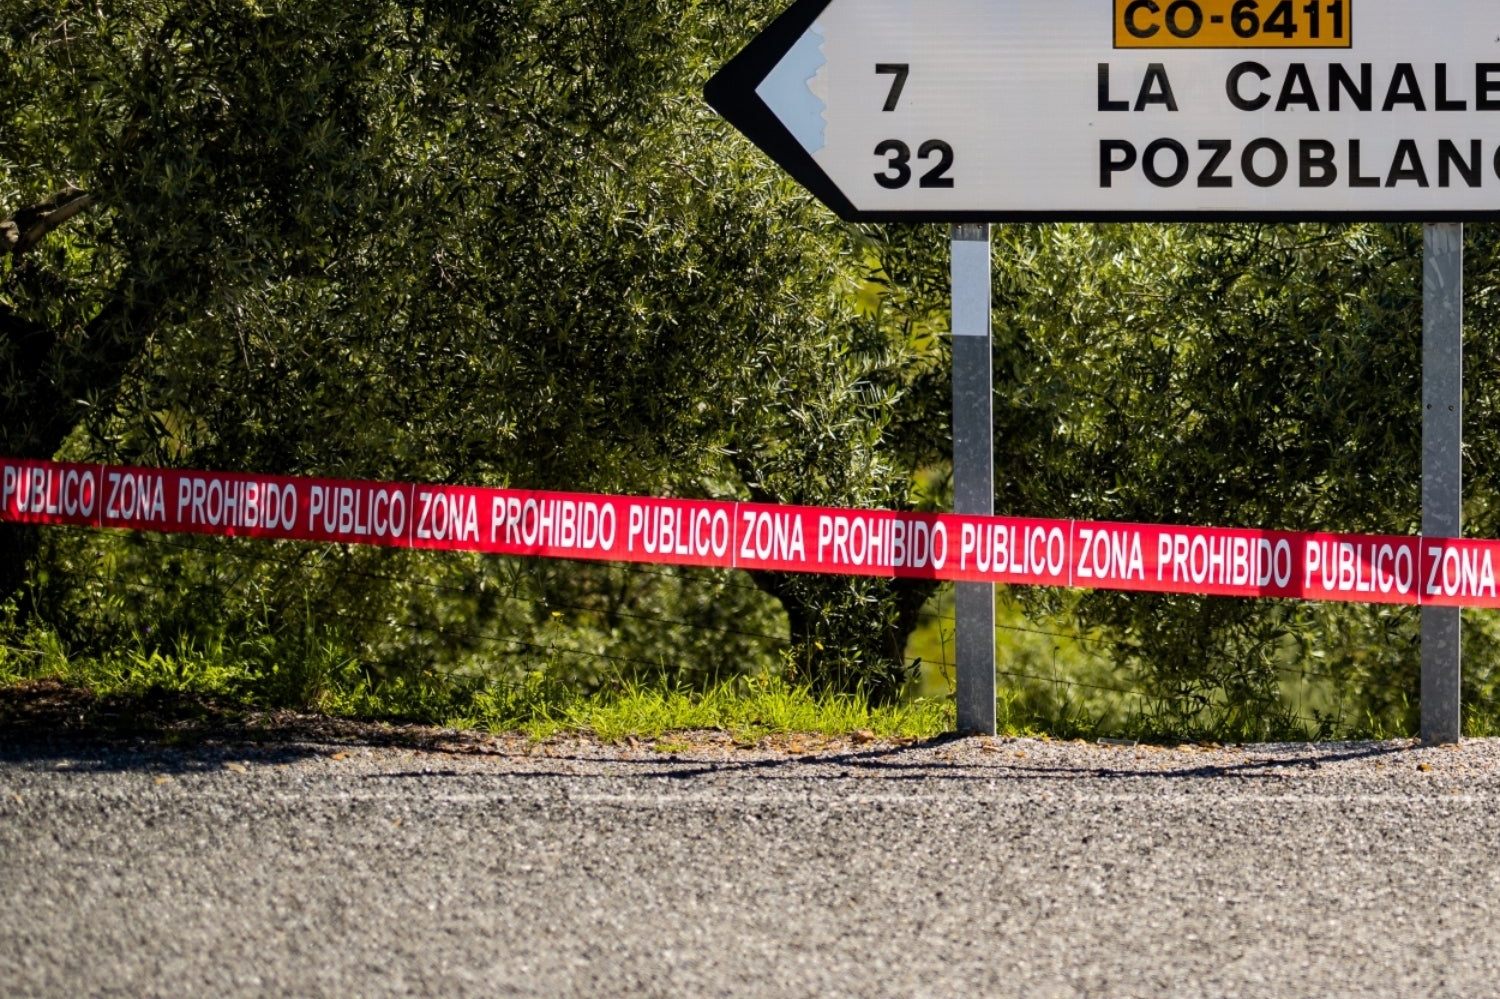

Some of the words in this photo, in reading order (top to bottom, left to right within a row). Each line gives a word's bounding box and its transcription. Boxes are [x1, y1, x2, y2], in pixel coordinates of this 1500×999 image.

[1124, 0, 1343, 39] CO-6411
[874, 62, 910, 112] 7
[1097, 62, 1178, 112] LA
[873, 139, 954, 190] 32
[3, 466, 94, 517] PUBLICO
[106, 472, 166, 522] ZONA
[178, 477, 297, 531] PROHIBIDO
[309, 485, 405, 537] PUBLICO
[417, 492, 479, 542] ZONA
[491, 496, 614, 550] PROHIBIDO
[628, 504, 728, 557] PUBLICO
[740, 512, 805, 562] ZONA
[818, 515, 947, 569] PROHIBIDO
[961, 523, 1065, 577] PUBLICO
[1077, 530, 1144, 580] ZONA
[1158, 533, 1291, 588] PROHIBIDO
[1306, 542, 1412, 594] PUBLICO
[1426, 547, 1497, 597] ZONA
